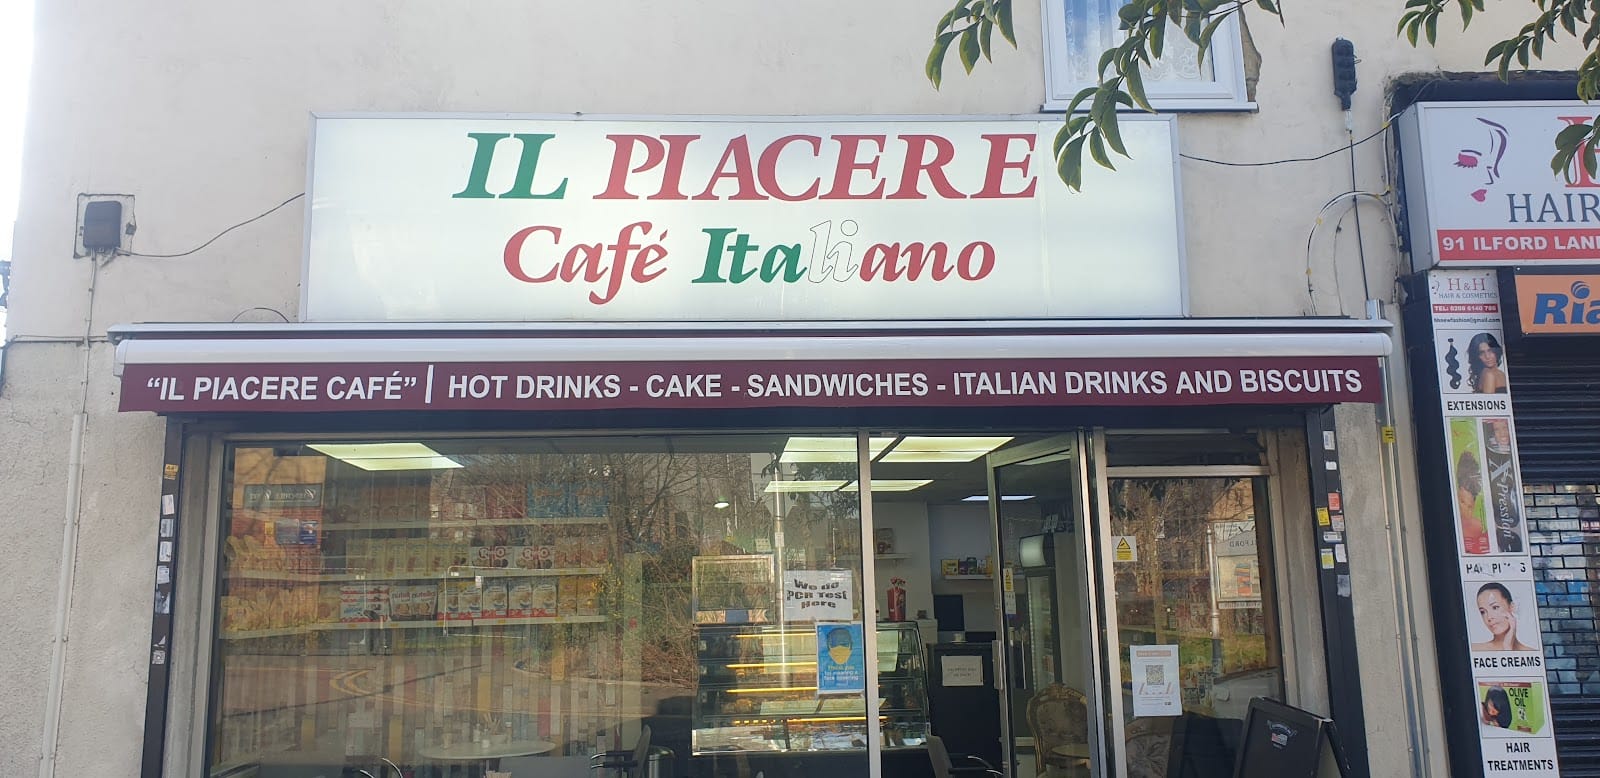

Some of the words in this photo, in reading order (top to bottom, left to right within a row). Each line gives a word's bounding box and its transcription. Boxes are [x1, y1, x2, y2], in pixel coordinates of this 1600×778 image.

[452, 132, 568, 200] IL
[593, 133, 1037, 202] PIACERE
[1506, 193, 1600, 223] HAIR
[1443, 237, 1466, 251] 91
[1473, 236, 1548, 251] ILFORD
[503, 220, 668, 305] Café
[692, 219, 995, 284] Italiano
[1533, 281, 1600, 325] Ria
[193, 375, 318, 400] PIACERE
[448, 374, 509, 399] HOT
[516, 374, 621, 399] DRINKS
[646, 374, 722, 398] CAKE
[747, 373, 929, 398] SANDWICHES
[953, 371, 1057, 395] ITALIAN
[1065, 371, 1168, 394] DRINKS
[1176, 370, 1232, 394] AND
[1240, 369, 1362, 393] BISCUITS
[1447, 401, 1506, 411] EXTENSIONS
[794, 578, 817, 590] We
[821, 581, 840, 590] do
[786, 590, 813, 600] PCR
[818, 590, 848, 600] Test
[801, 600, 836, 609] Here
[1474, 656, 1498, 668] FACE
[1501, 656, 1541, 667] CREAMS
[1509, 688, 1529, 698] OLIVE
[1515, 698, 1526, 707] OIL
[1506, 742, 1531, 753] HAIR
[1487, 759, 1554, 771] TREATMENTS
